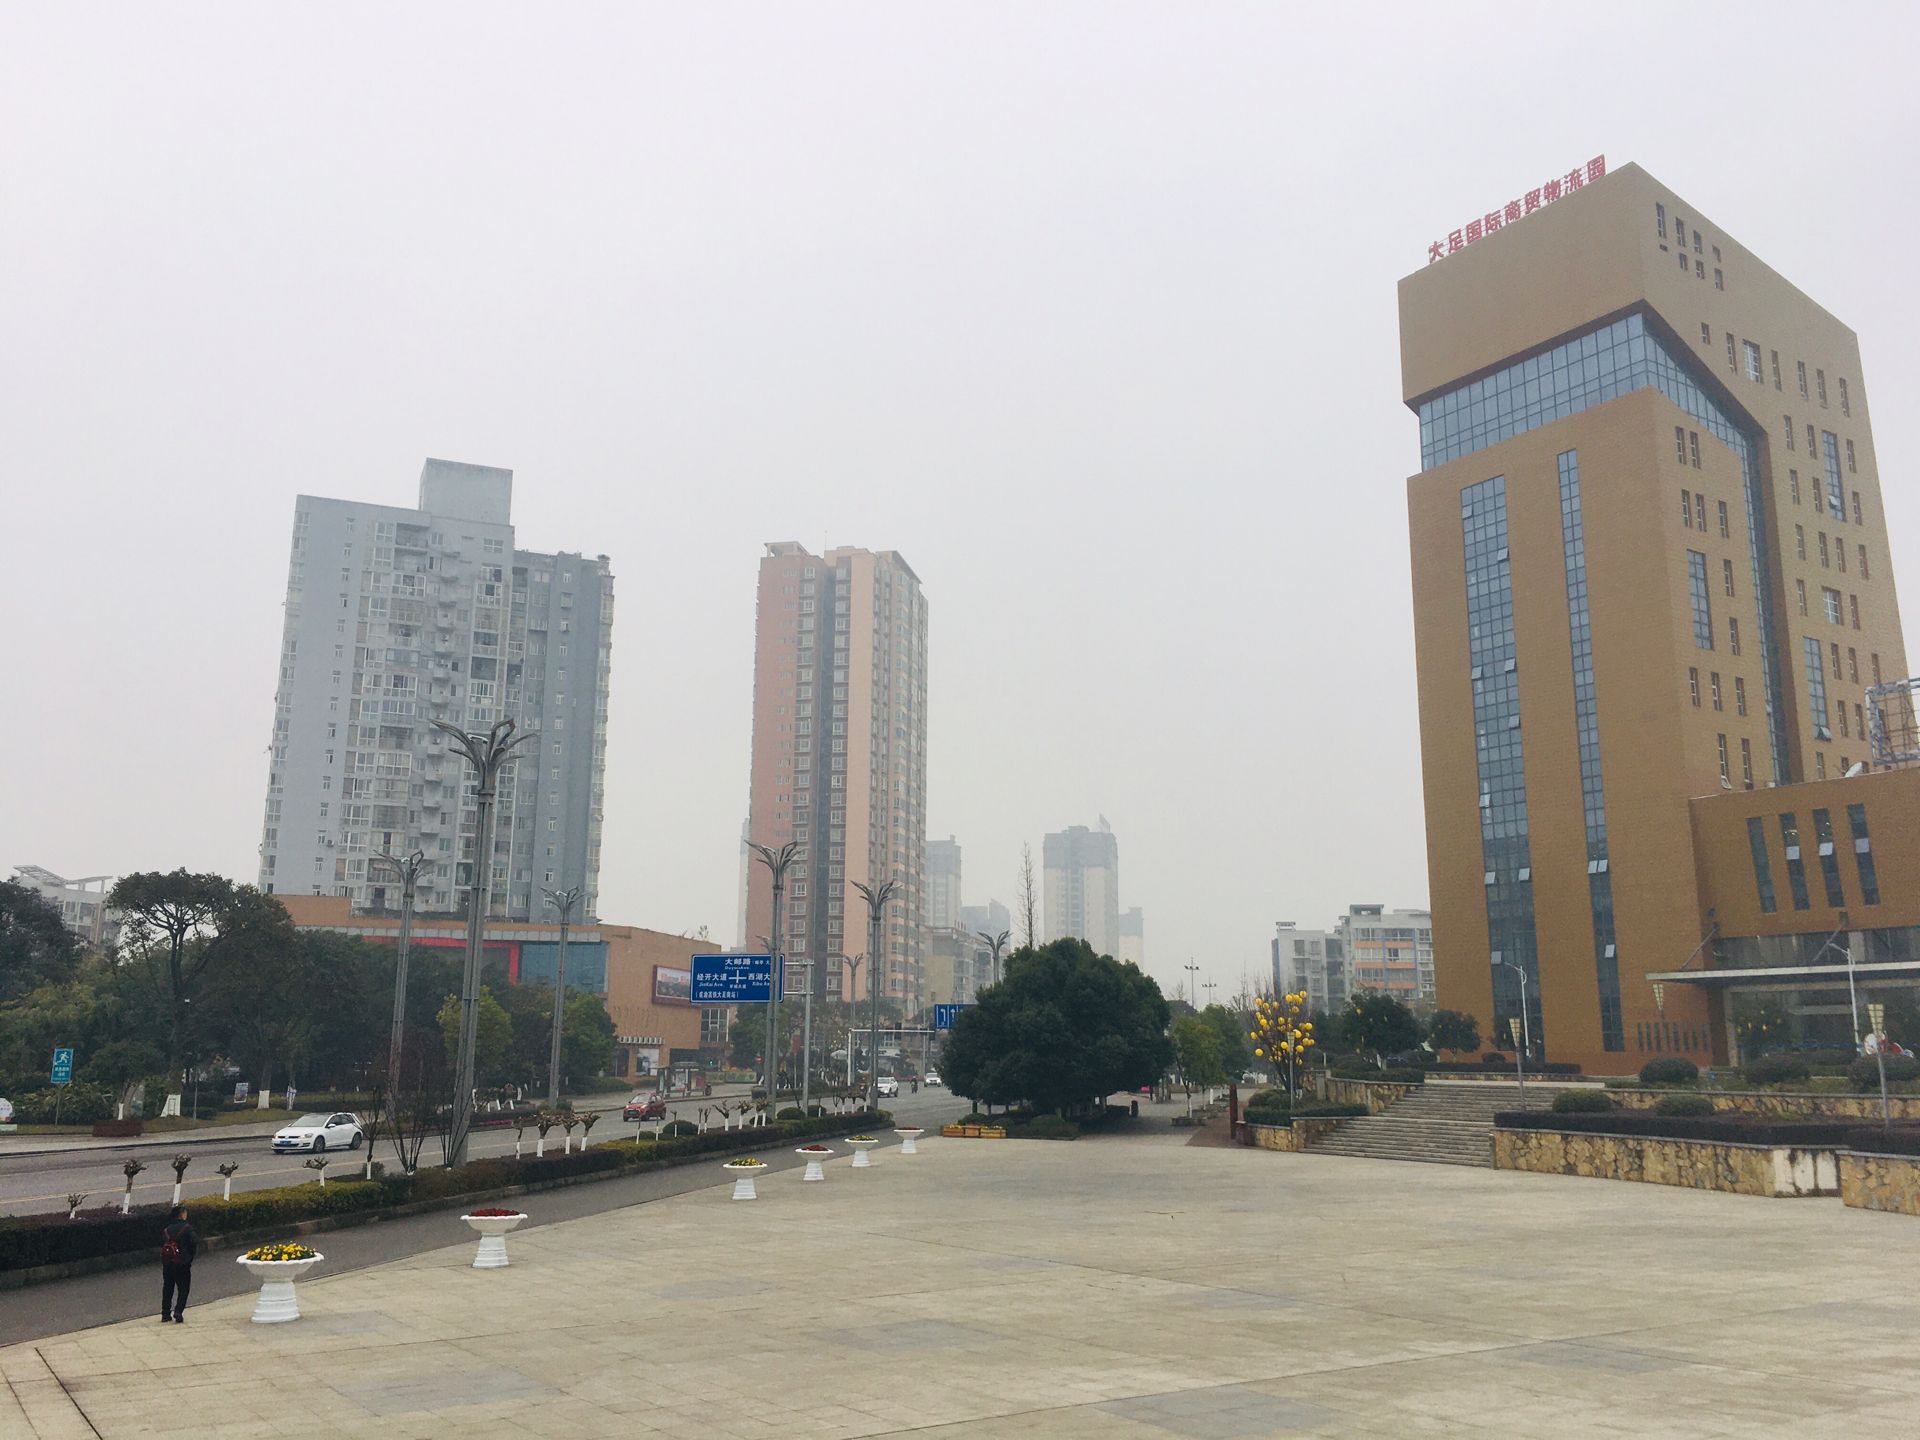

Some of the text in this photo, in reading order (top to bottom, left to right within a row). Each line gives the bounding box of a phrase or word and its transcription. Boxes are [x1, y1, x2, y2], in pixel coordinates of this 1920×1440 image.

[1428, 154, 1606, 263] 大足国际商贸物流园
[696, 973, 727, 981] 经开大道
